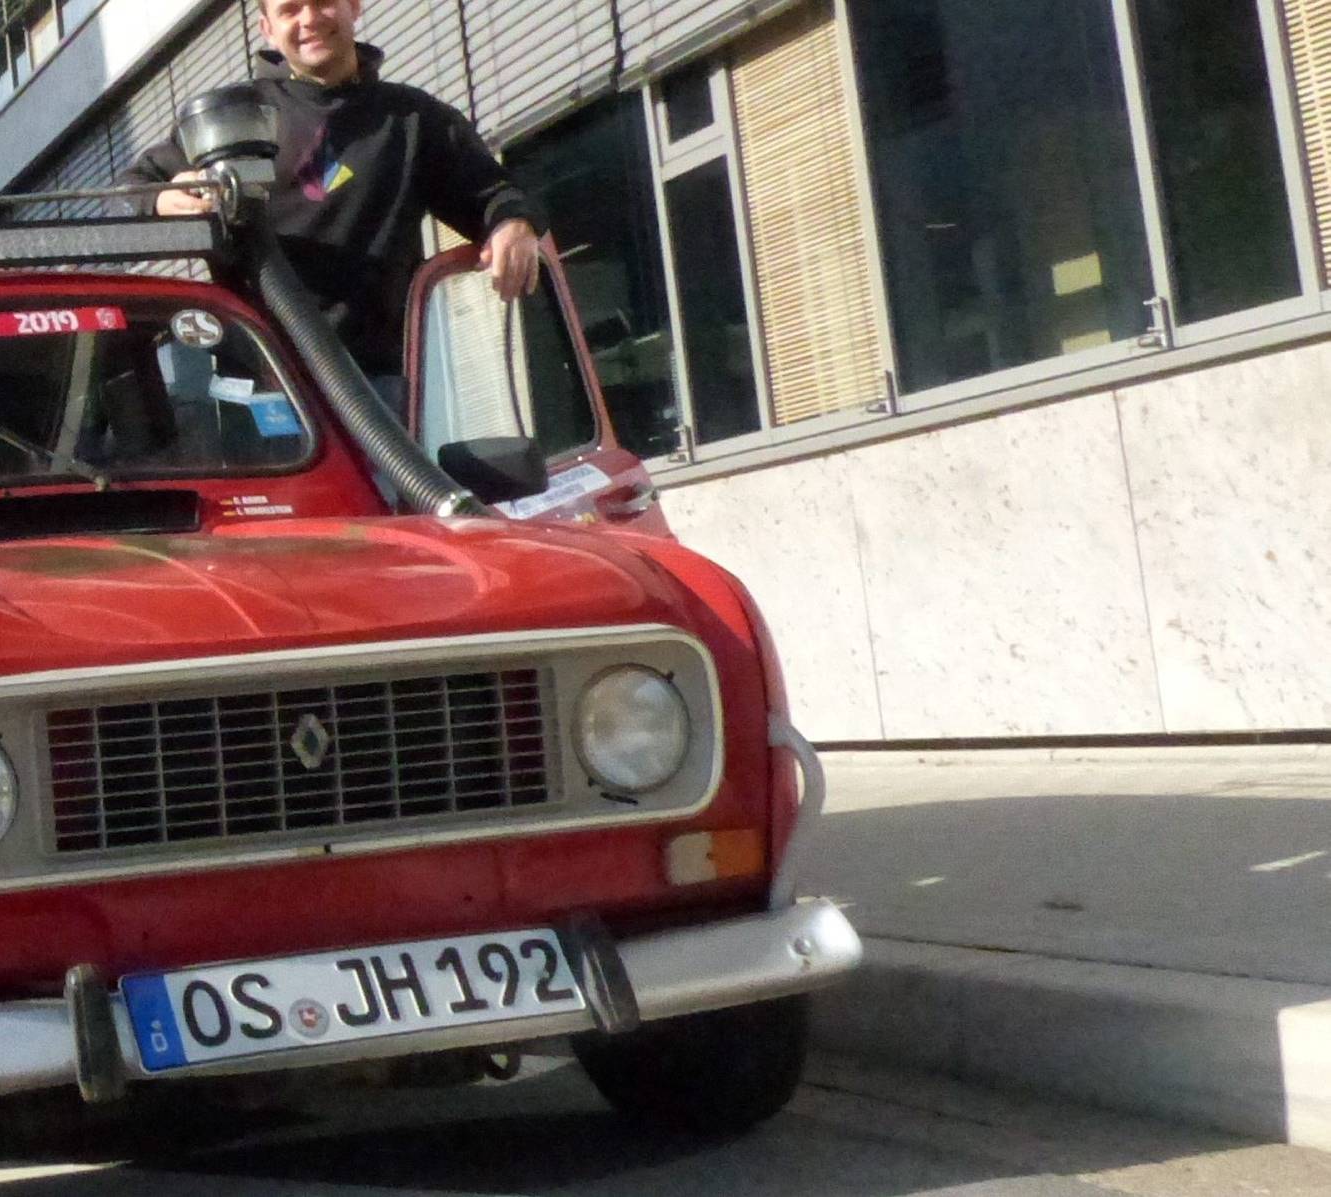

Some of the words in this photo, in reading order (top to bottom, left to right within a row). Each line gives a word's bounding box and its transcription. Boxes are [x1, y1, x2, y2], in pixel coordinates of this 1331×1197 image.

[13, 310, 79, 335] 2019
[182, 972, 283, 1047] OS
[335, 951, 430, 1026] JH
[435, 937, 577, 1012] 192
